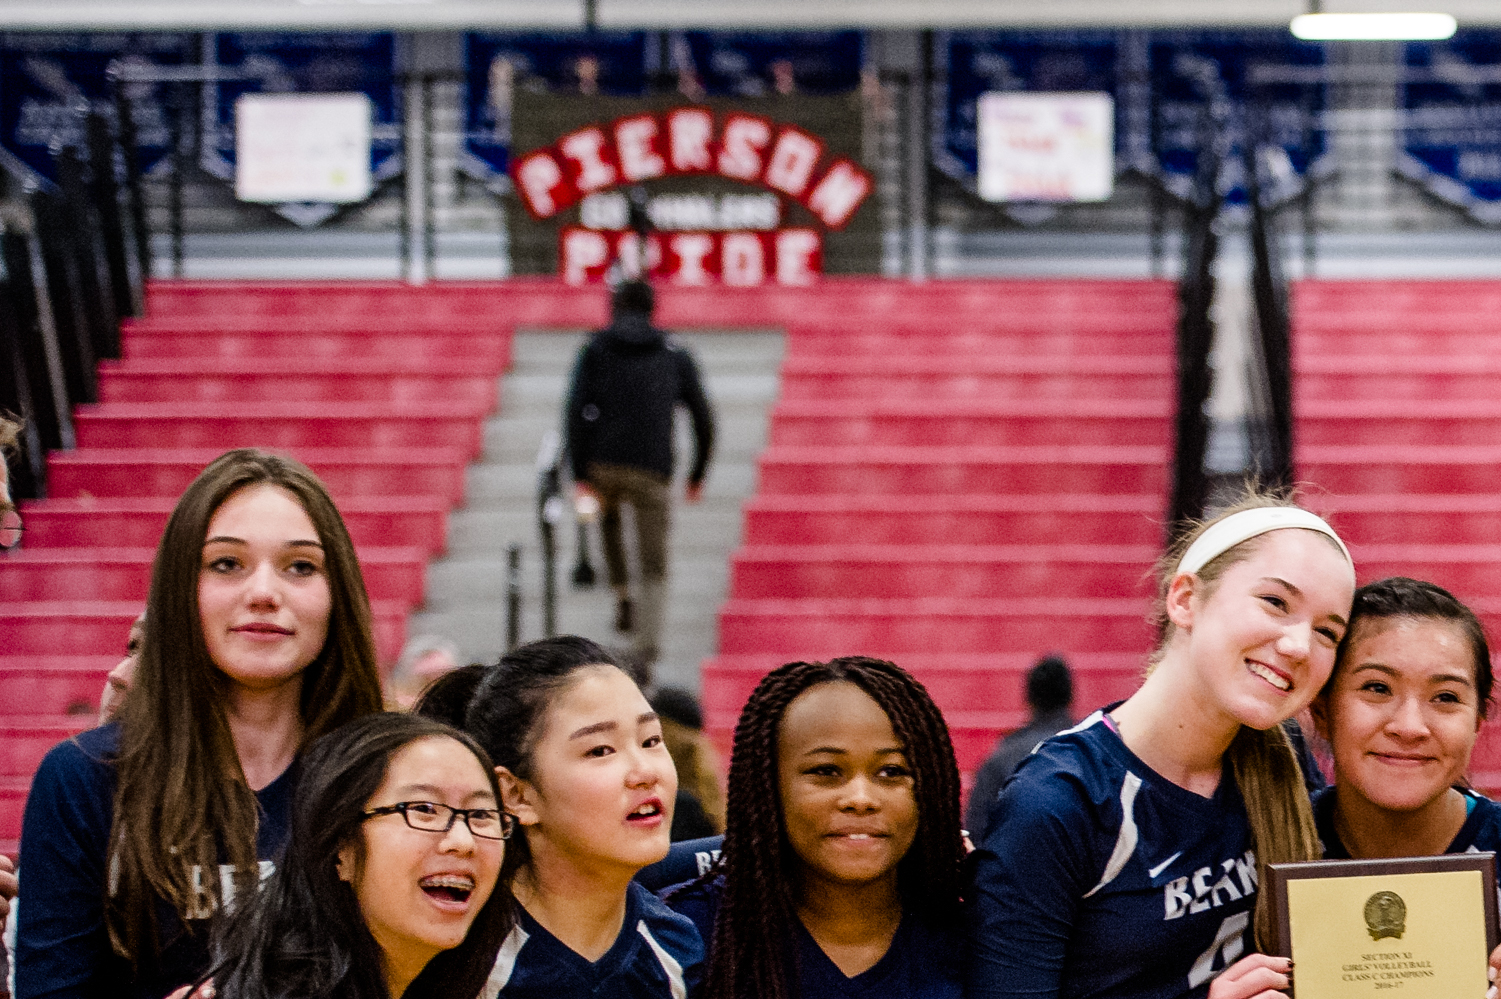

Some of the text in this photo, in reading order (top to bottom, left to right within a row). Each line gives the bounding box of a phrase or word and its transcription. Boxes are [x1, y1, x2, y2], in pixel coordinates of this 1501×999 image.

[514, 107, 871, 228] PIERSON
[563, 228, 821, 287] PRIDE
[1164, 849, 1259, 921] BEAR
[1361, 953, 1400, 961] SECTION
[1373, 961, 1432, 970] VOLLEYBALL
[1342, 973, 1371, 981] CLASS
[1380, 971, 1435, 979] CHAMPIONS
